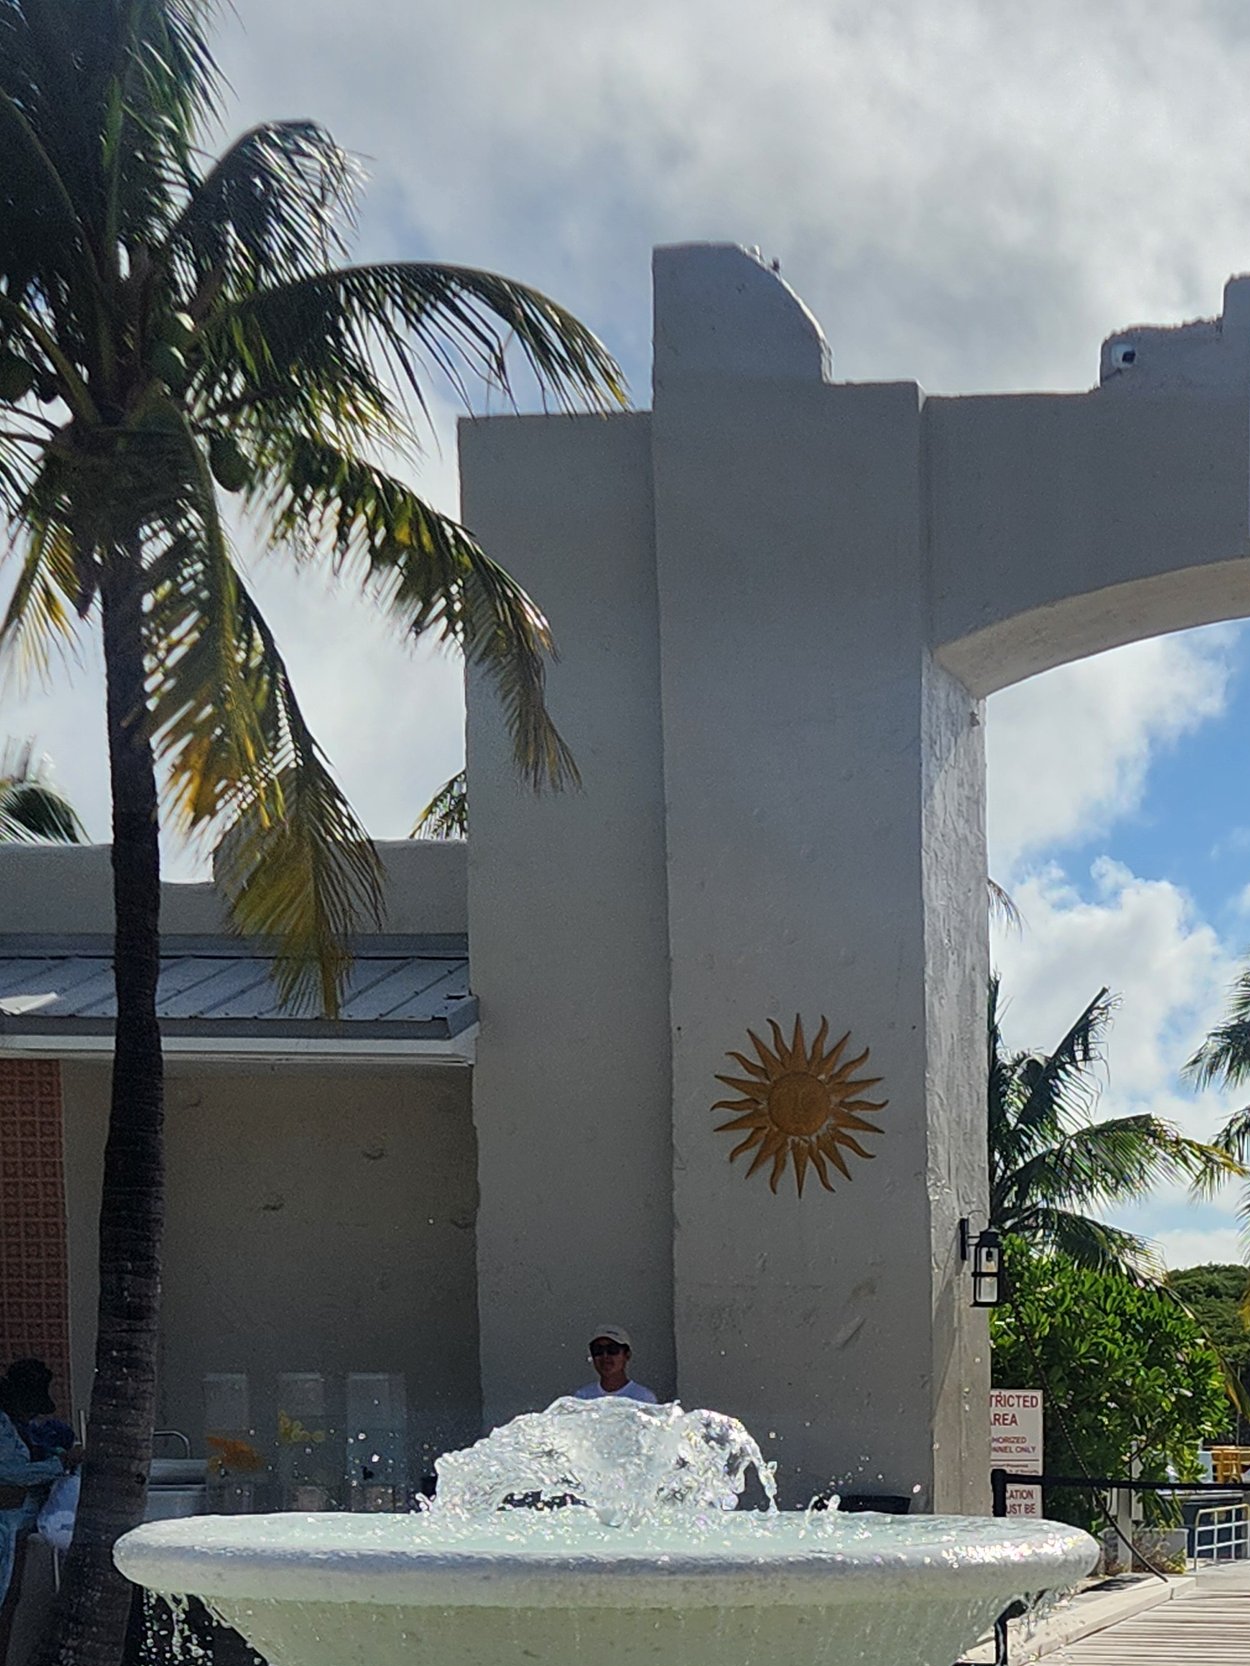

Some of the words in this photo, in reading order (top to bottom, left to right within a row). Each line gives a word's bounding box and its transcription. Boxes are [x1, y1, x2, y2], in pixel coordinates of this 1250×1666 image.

[990, 1413, 1018, 1426] REA
[1006, 1489, 1034, 1500] ATION
[1024, 1503, 1036, 1514] BE
